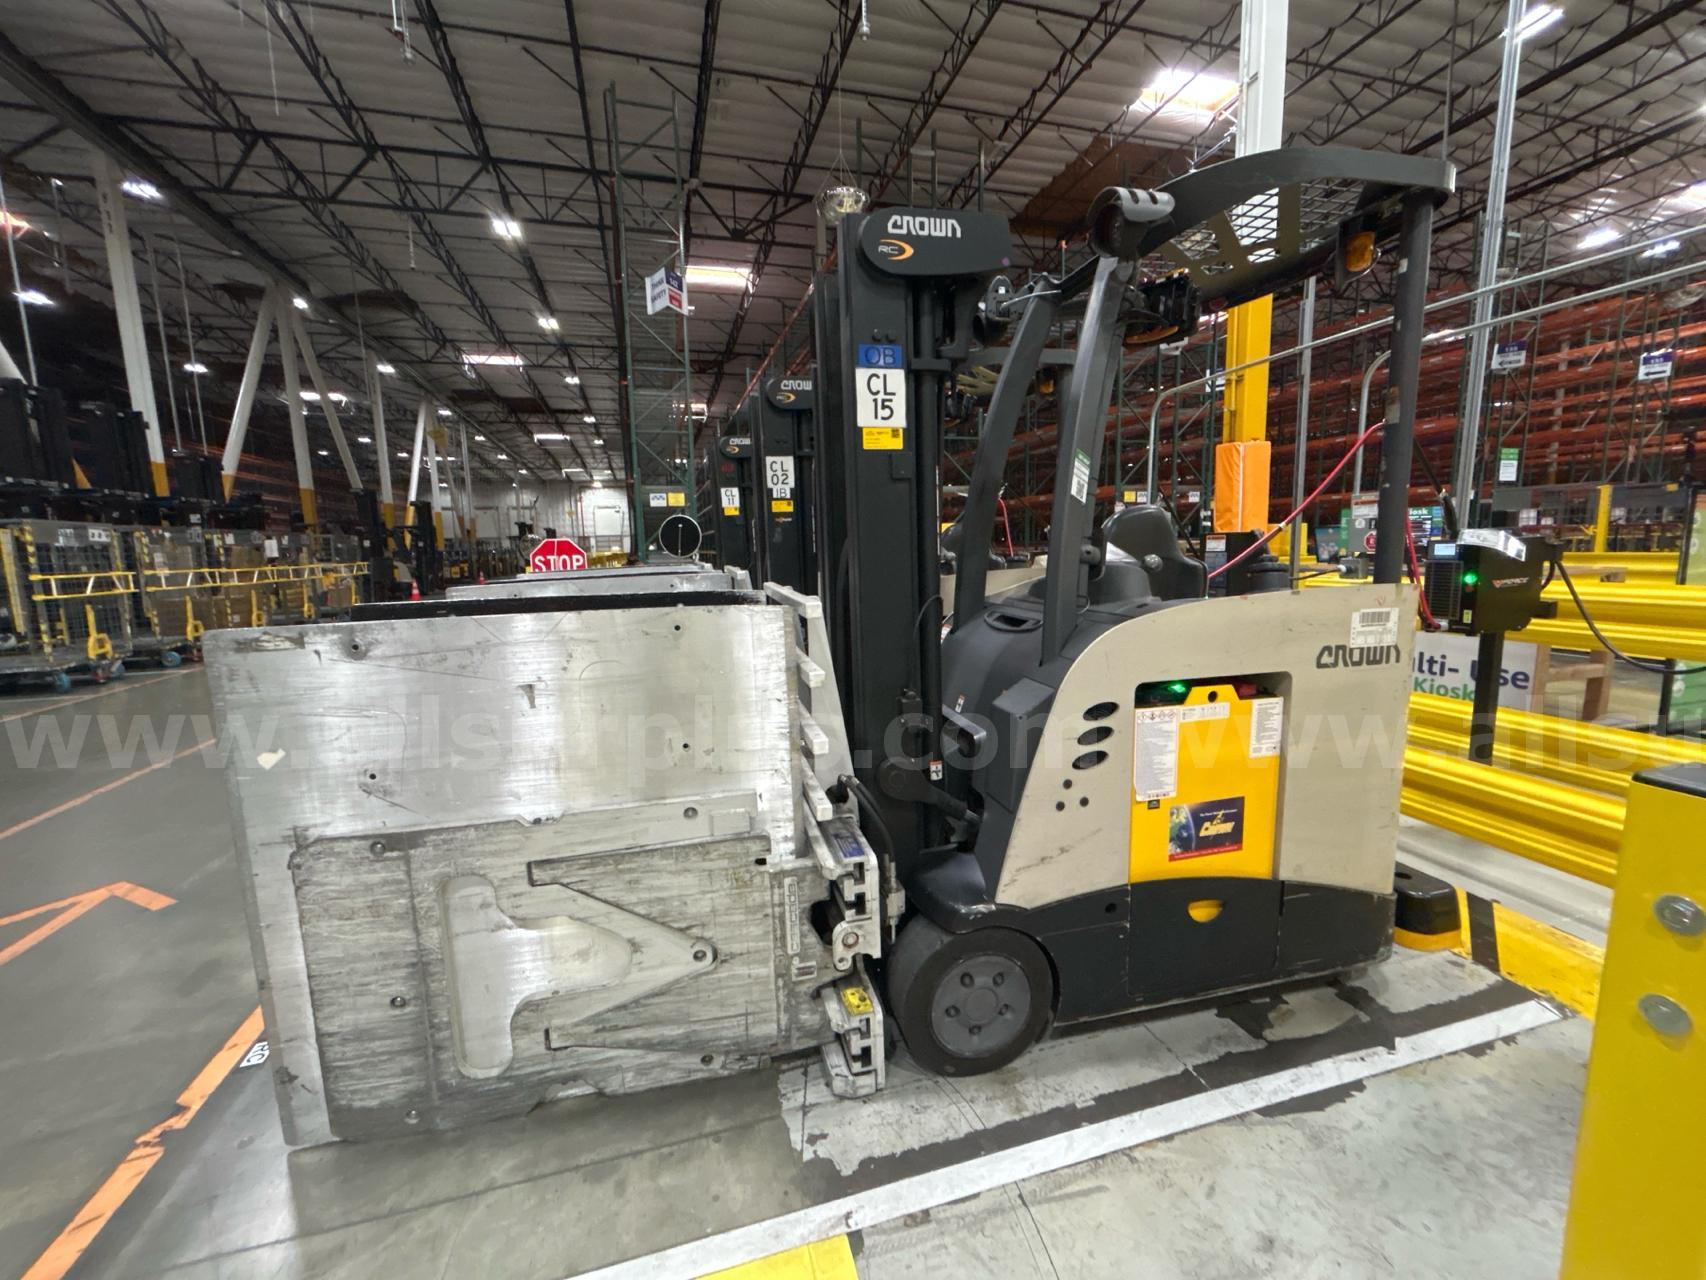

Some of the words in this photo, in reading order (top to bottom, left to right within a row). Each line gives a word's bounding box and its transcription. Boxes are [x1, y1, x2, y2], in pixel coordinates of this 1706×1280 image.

[887, 215, 962, 238] CROWN
[878, 245, 899, 254] RC
[864, 346, 896, 366] OB
[867, 373, 896, 396] CL
[873, 398, 894, 420] 15
[770, 460, 788, 472] CL
[771, 474, 789, 486] 02
[724, 489, 736, 497] CL
[534, 555, 584, 571] STOP
[1316, 645, 1401, 669] CROWN
[1412, 651, 1459, 676] lti-
[1413, 676, 1475, 701] Kiosk
